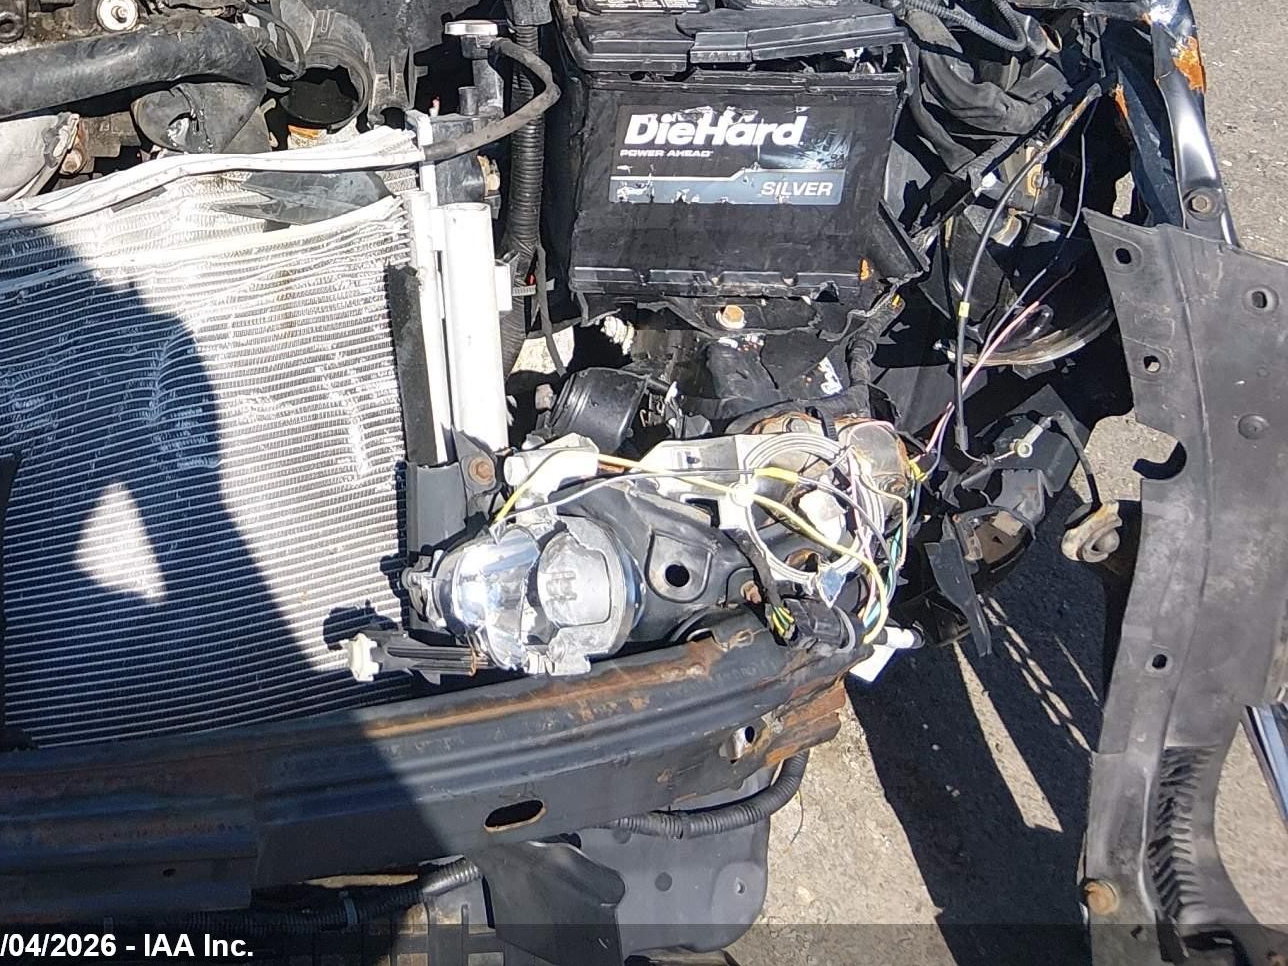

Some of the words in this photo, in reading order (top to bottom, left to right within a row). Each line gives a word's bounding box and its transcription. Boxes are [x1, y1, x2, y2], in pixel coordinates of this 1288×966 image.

[624, 113, 808, 146] DieHard
[619, 149, 665, 157] POWER
[761, 181, 834, 197] SILVER
